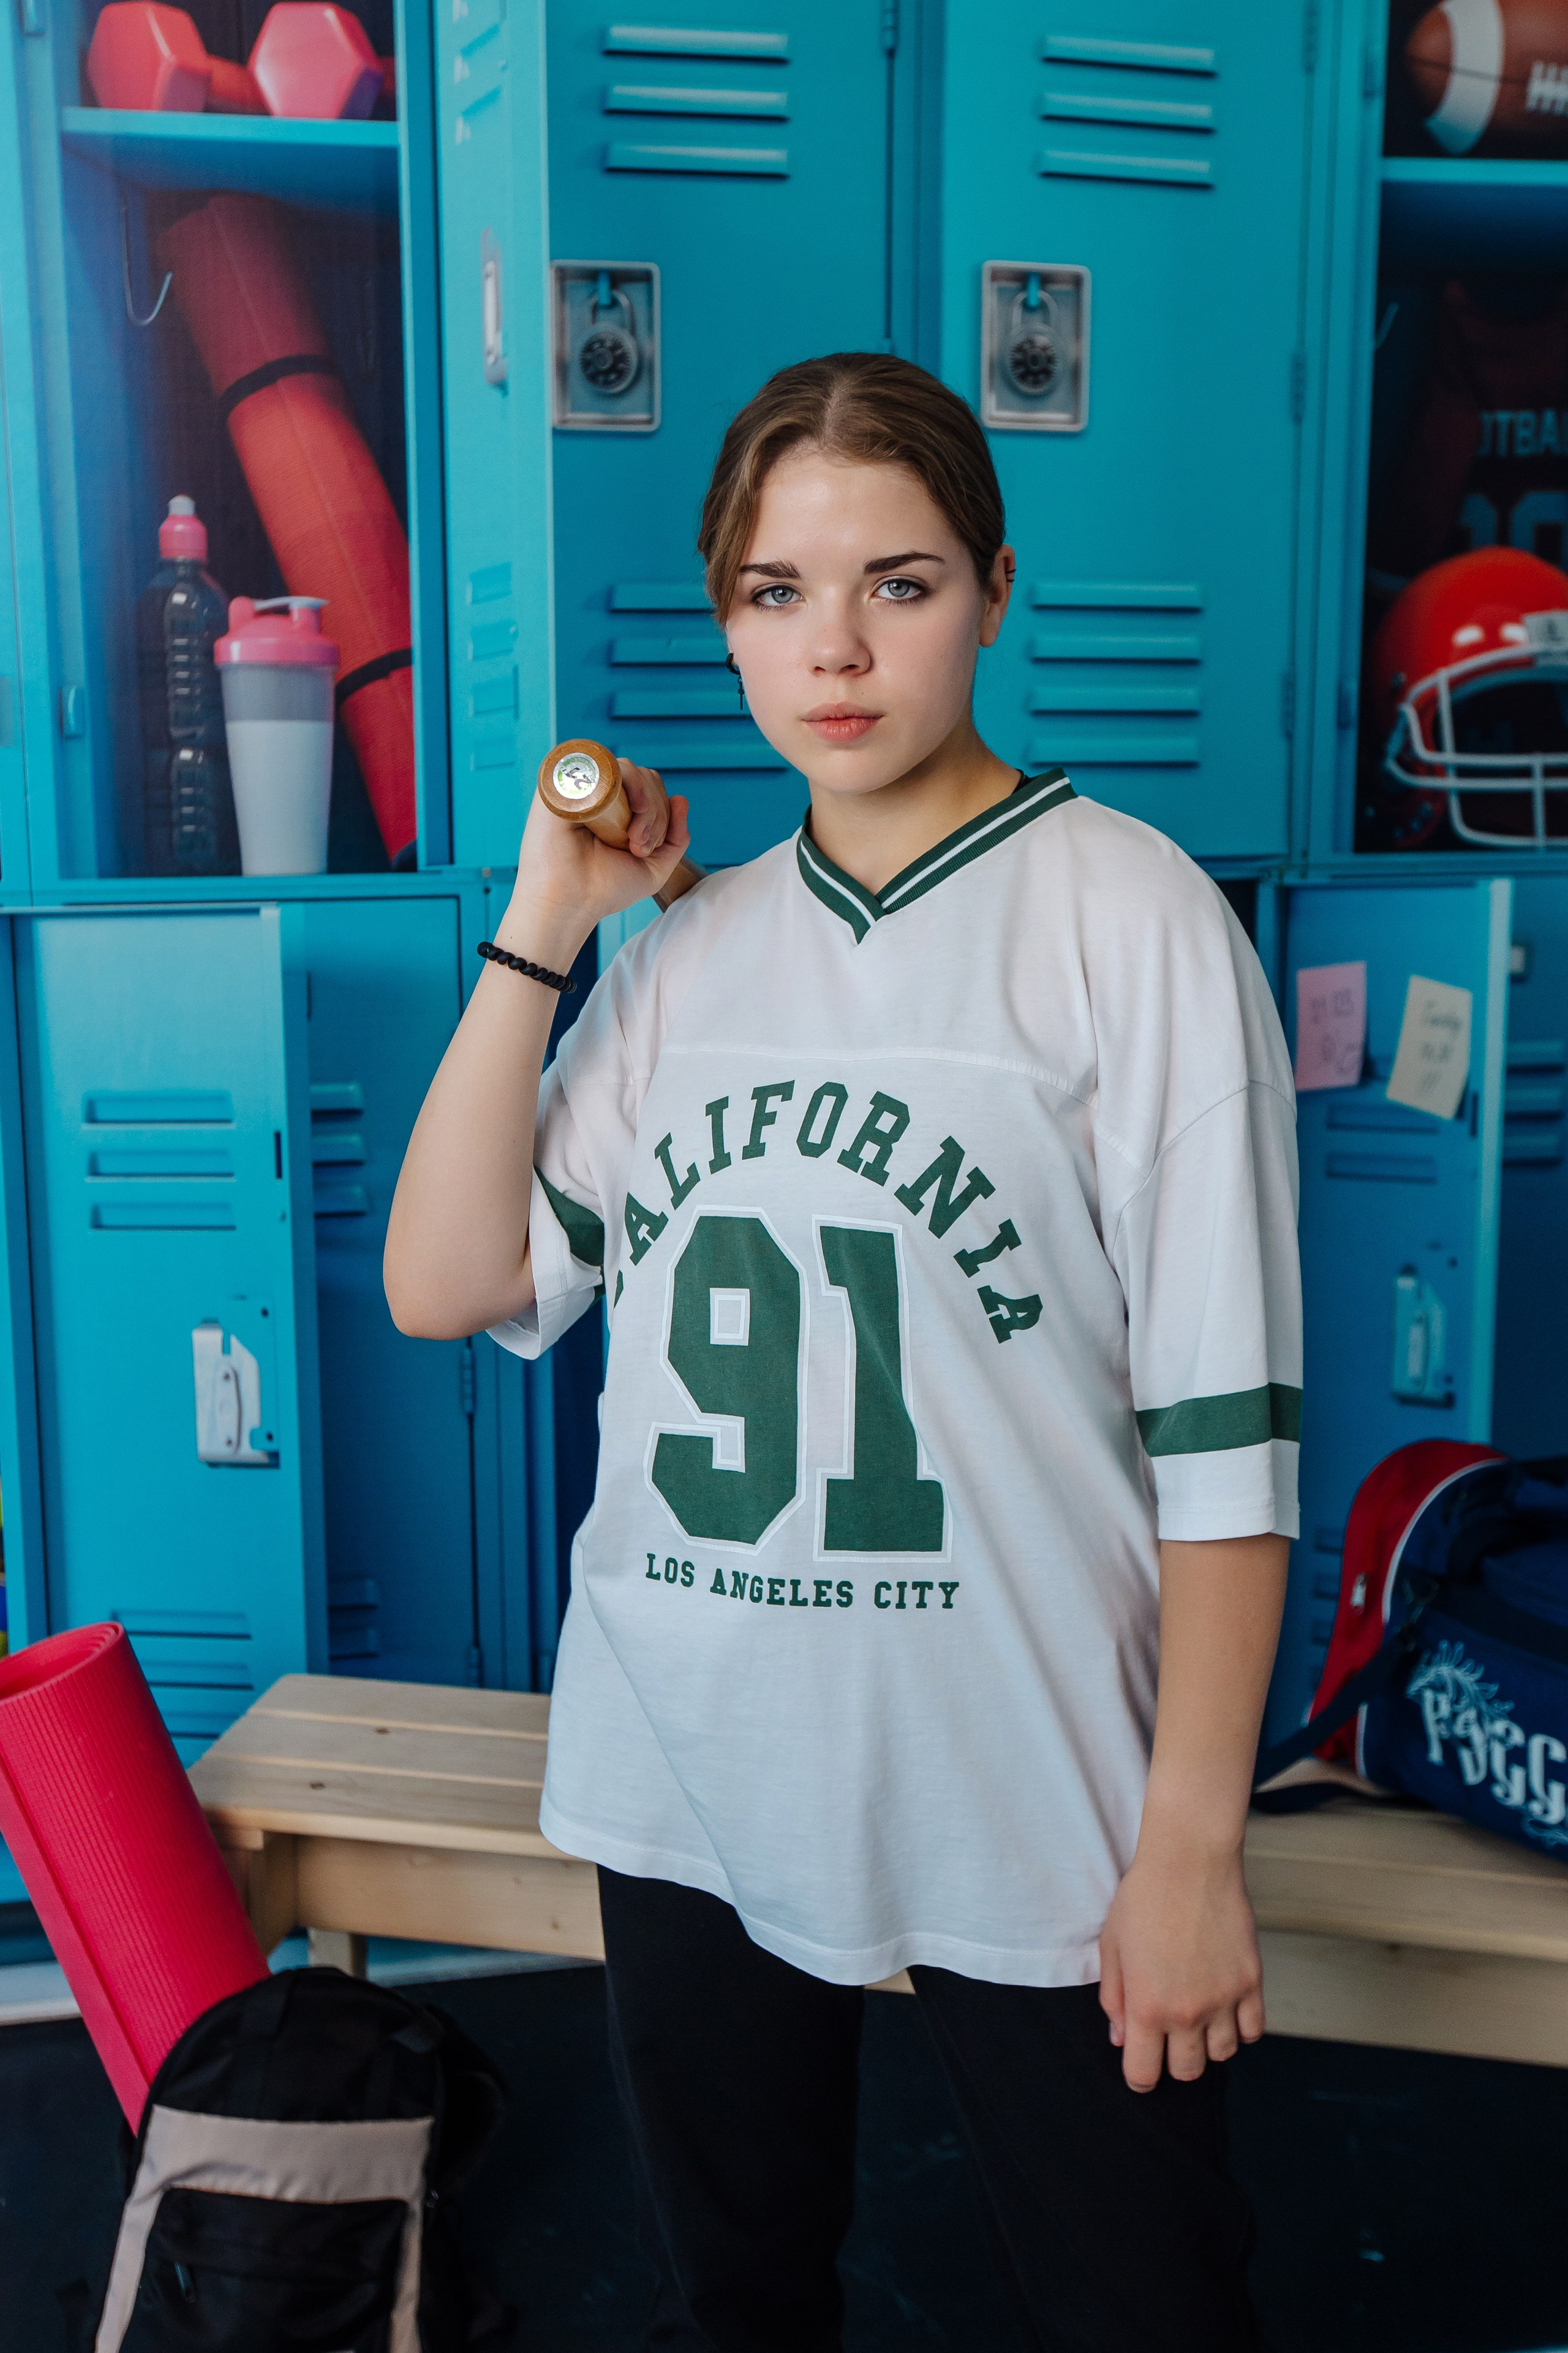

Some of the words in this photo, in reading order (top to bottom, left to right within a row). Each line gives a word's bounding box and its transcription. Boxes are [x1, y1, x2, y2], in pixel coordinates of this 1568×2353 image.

[614, 1079, 1044, 1343] ALIFORNIA
[644, 1206, 952, 1562] 91
[645, 1553, 696, 1588] LOS
[709, 1567, 854, 1609] ANGELES
[873, 1581, 960, 1610] CITY
